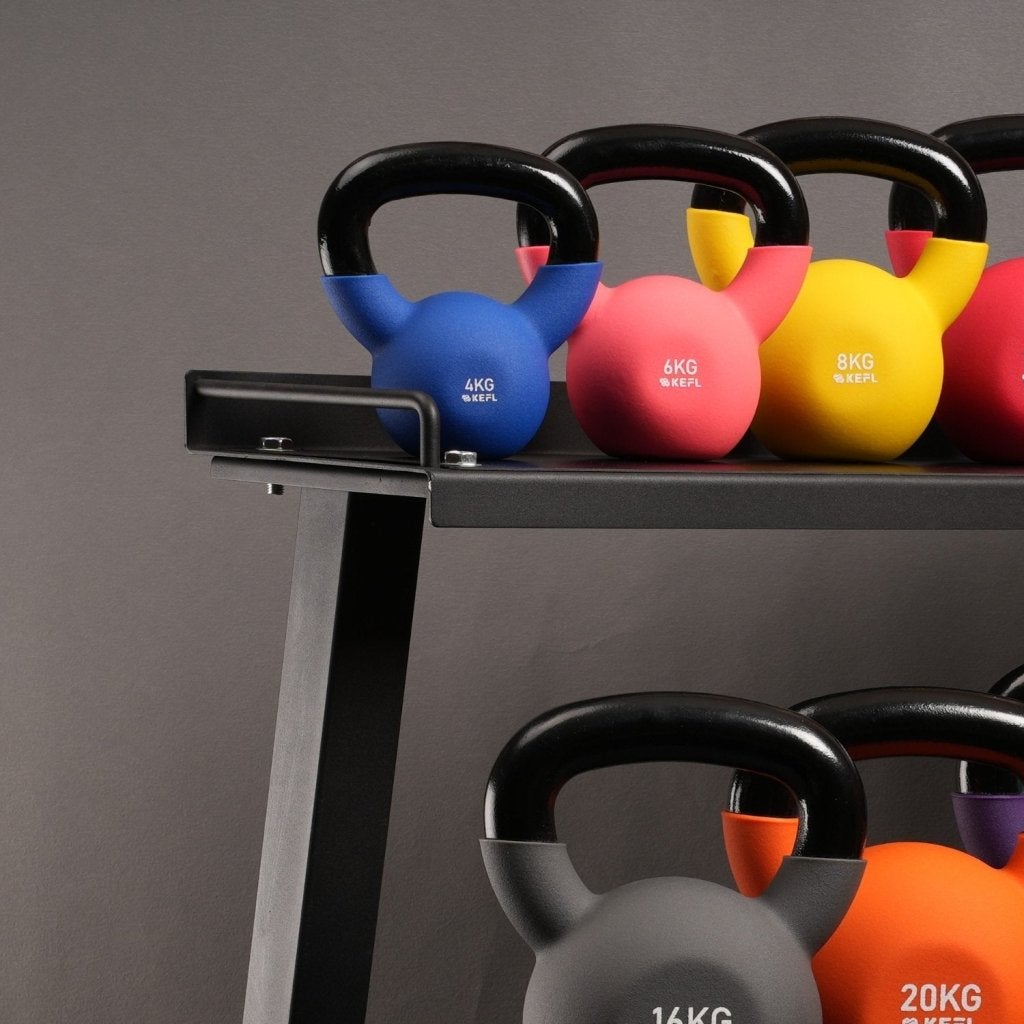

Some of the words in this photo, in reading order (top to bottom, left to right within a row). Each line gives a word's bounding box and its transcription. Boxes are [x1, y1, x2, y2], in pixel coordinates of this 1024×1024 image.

[663, 358, 698, 375] 6KG
[836, 353, 873, 370] 8KG
[464, 377, 495, 392] 4KG
[671, 377, 702, 388] KEFL
[846, 373, 878, 384] KEFL
[472, 393, 498, 402] KEFL
[900, 983, 982, 1012] 20KG
